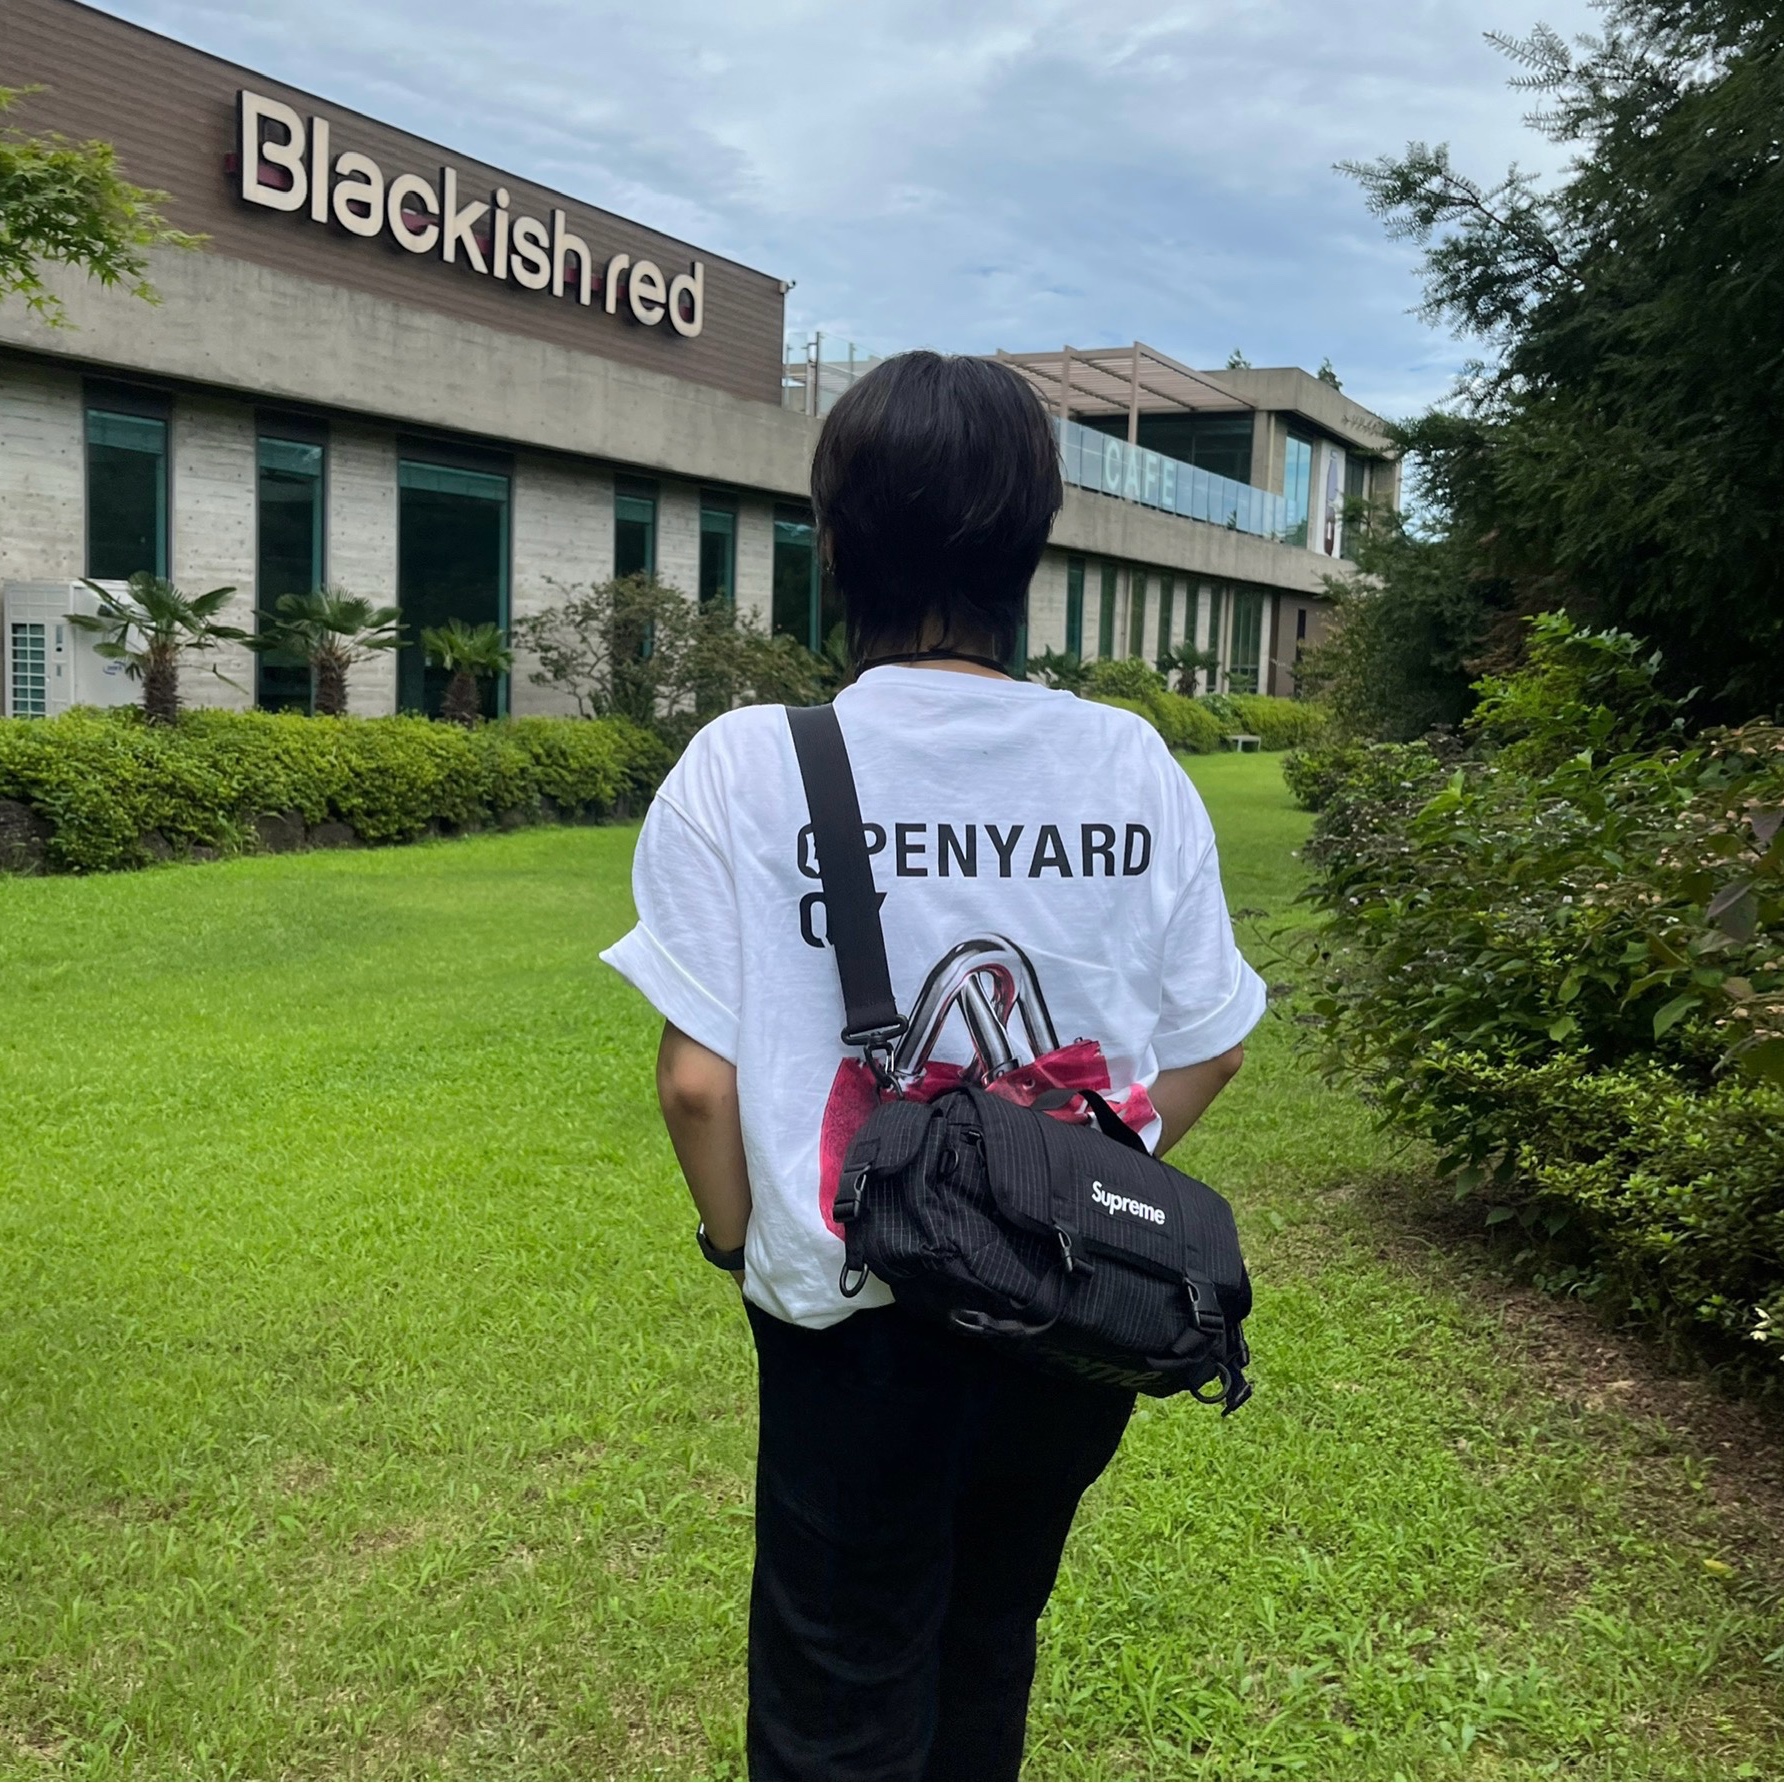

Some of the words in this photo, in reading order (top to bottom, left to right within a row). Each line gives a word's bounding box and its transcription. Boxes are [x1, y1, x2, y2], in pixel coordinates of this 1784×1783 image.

[240, 89, 592, 307] Blackish
[604, 260, 705, 339] red
[1105, 440, 1176, 506] CAFE
[1091, 1180, 1166, 1225] Supreme
